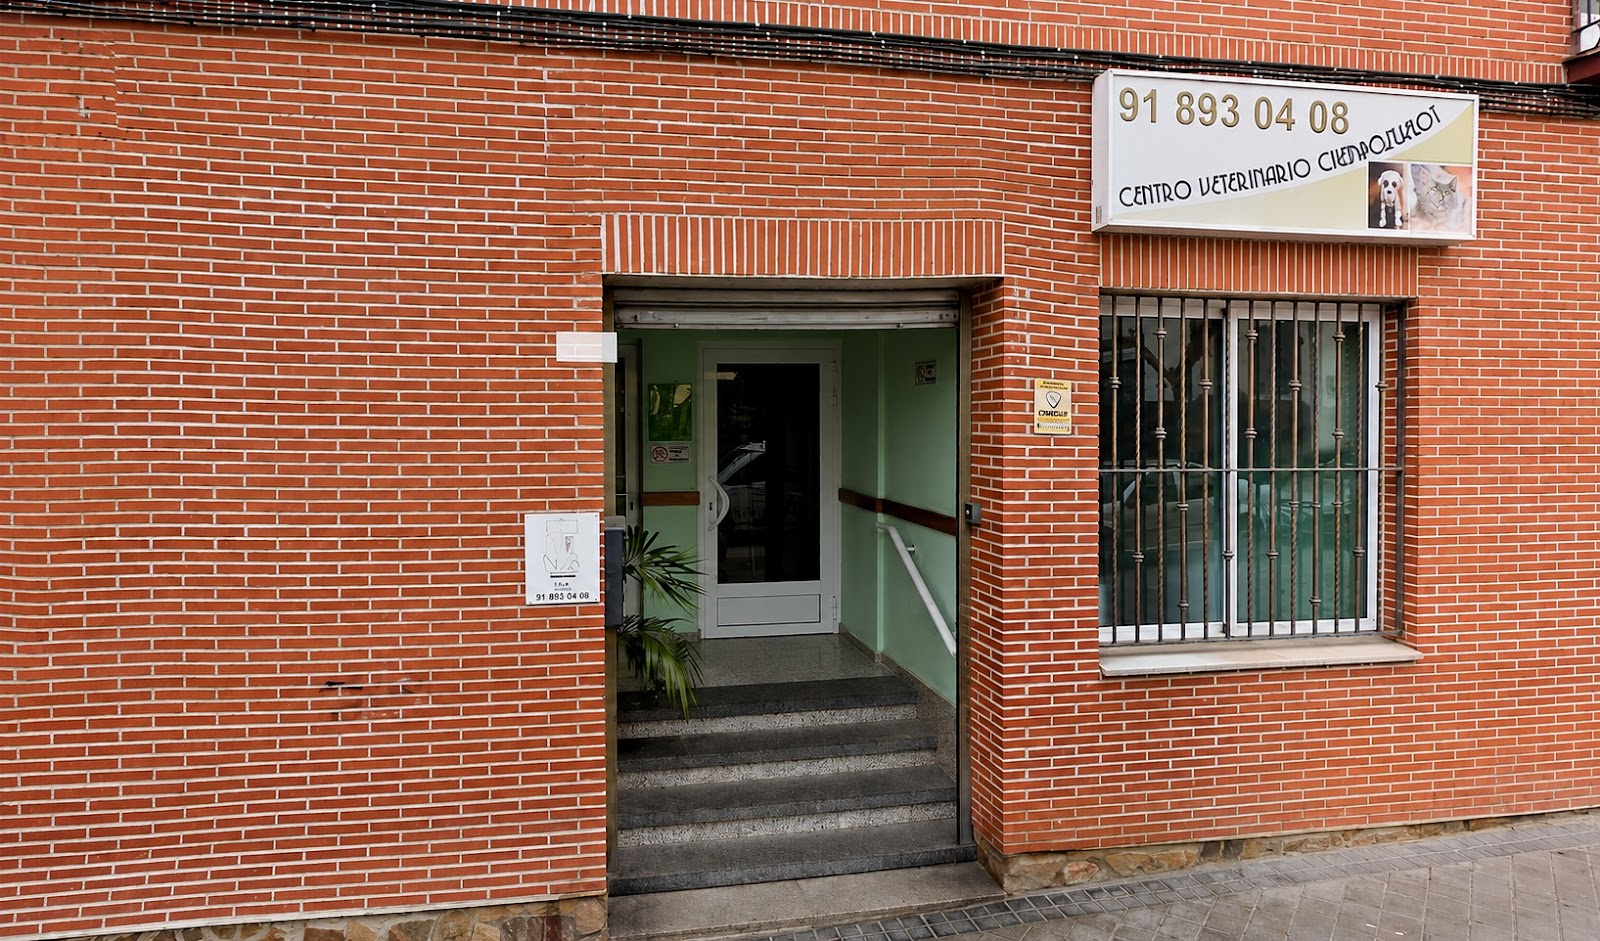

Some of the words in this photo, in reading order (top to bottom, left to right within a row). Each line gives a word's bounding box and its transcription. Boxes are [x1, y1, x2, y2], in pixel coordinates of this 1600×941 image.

[1119, 87, 1158, 123] 91
[1175, 90, 1240, 128] 893
[1254, 96, 1295, 132] 04
[1309, 100, 1349, 135] 08
[1119, 180, 1192, 207] CENTRO
[1198, 158, 1311, 197] VETERINARIO
[536, 593, 545, 601] 91
[567, 592, 577, 600] 04
